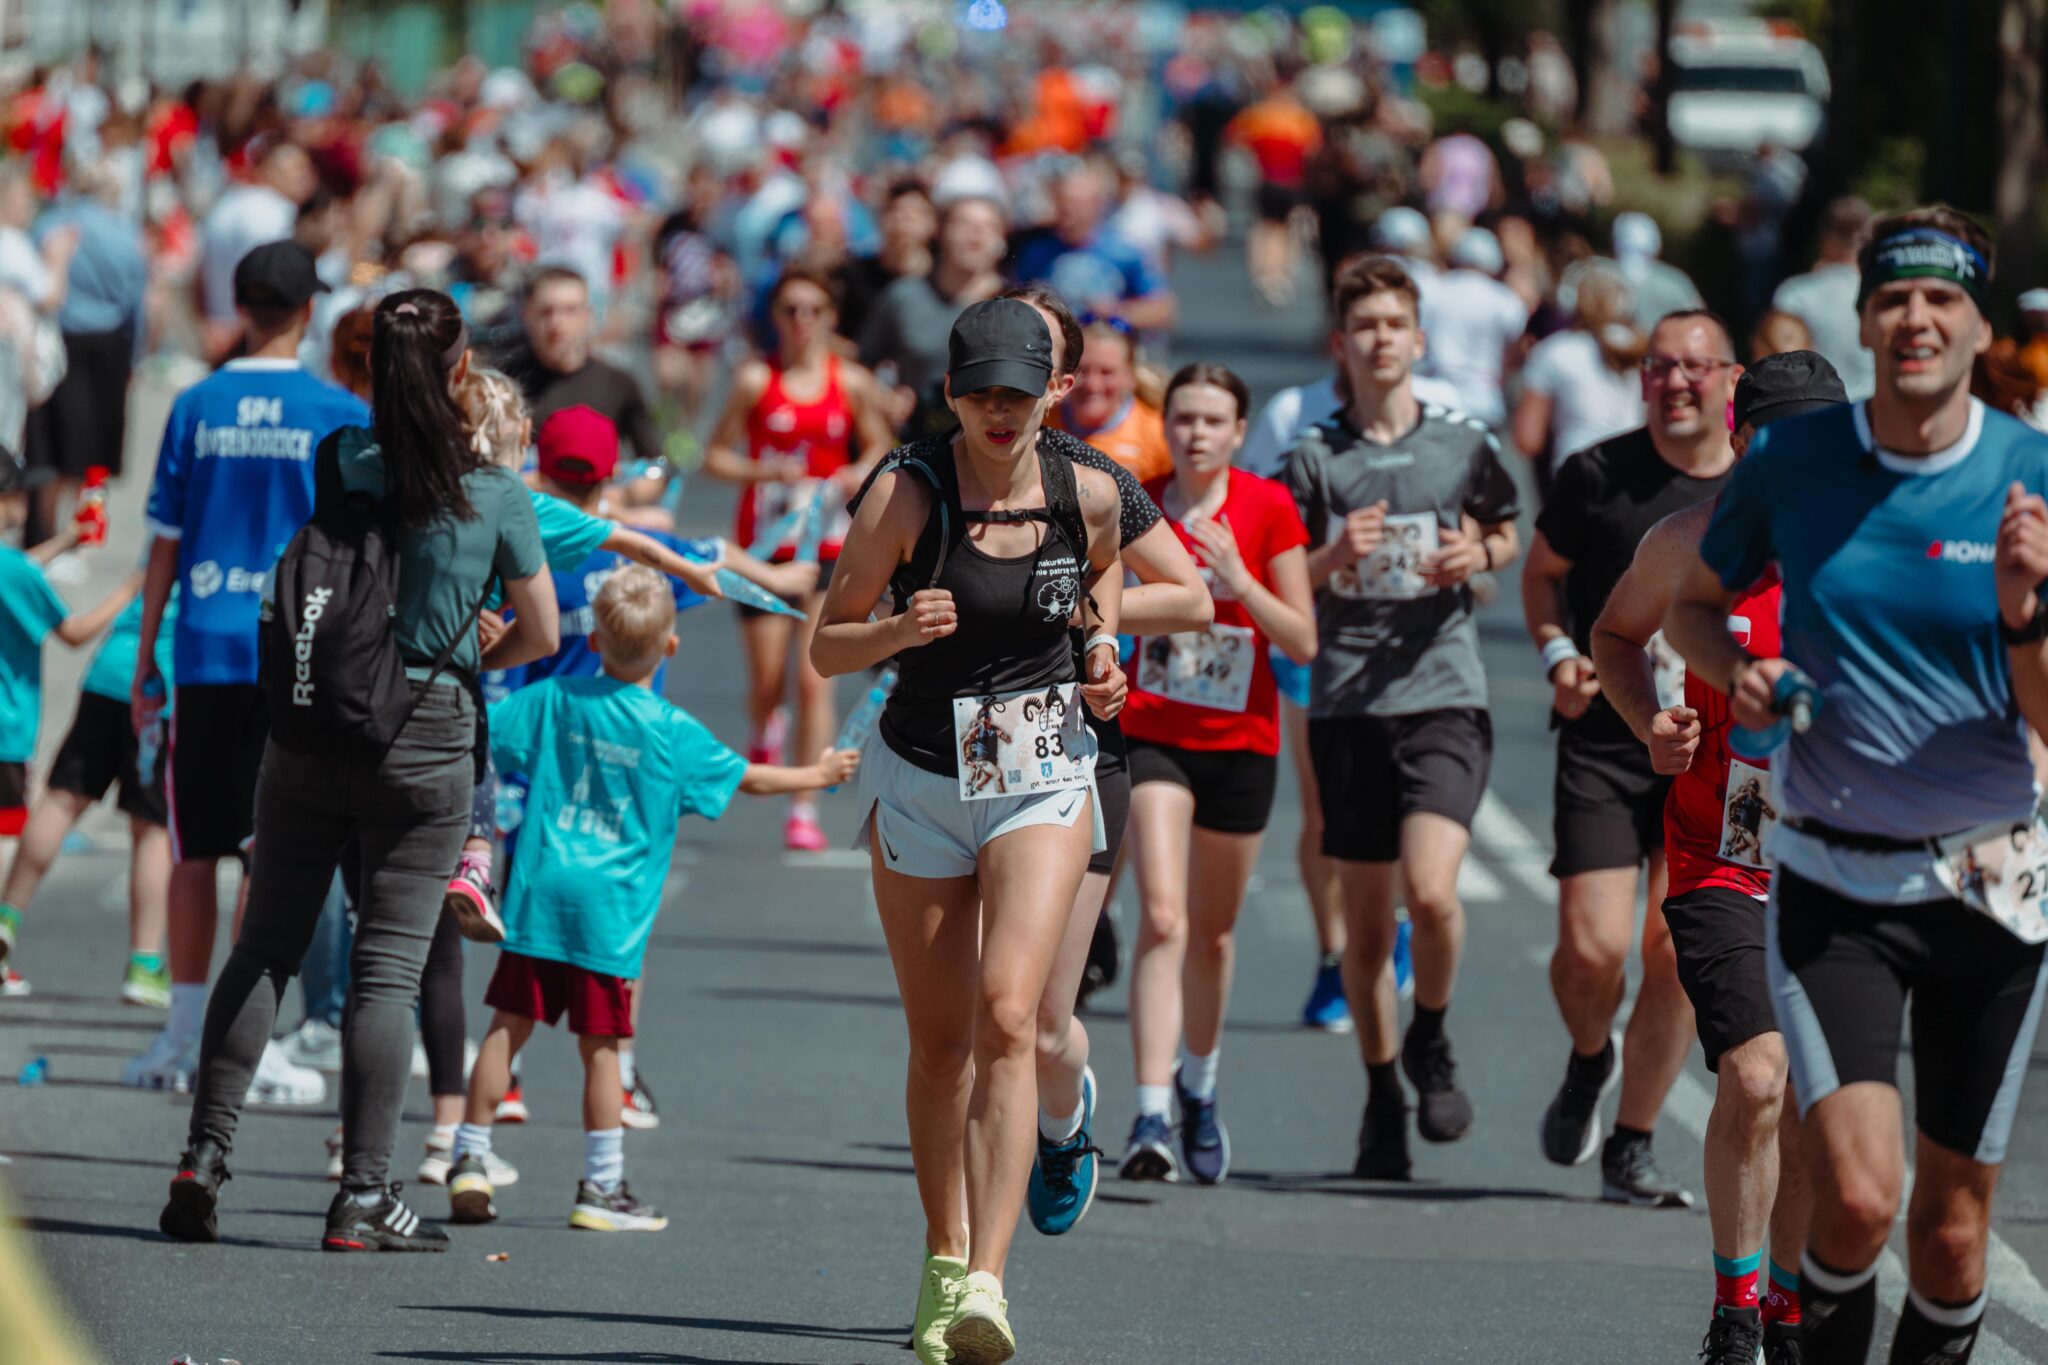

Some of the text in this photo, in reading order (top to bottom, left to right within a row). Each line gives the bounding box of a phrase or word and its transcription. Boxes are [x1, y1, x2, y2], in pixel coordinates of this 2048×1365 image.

[1036, 569, 1048, 577] nie
[293, 586, 334, 706] Reebok
[1035, 733, 1064, 759] 83
